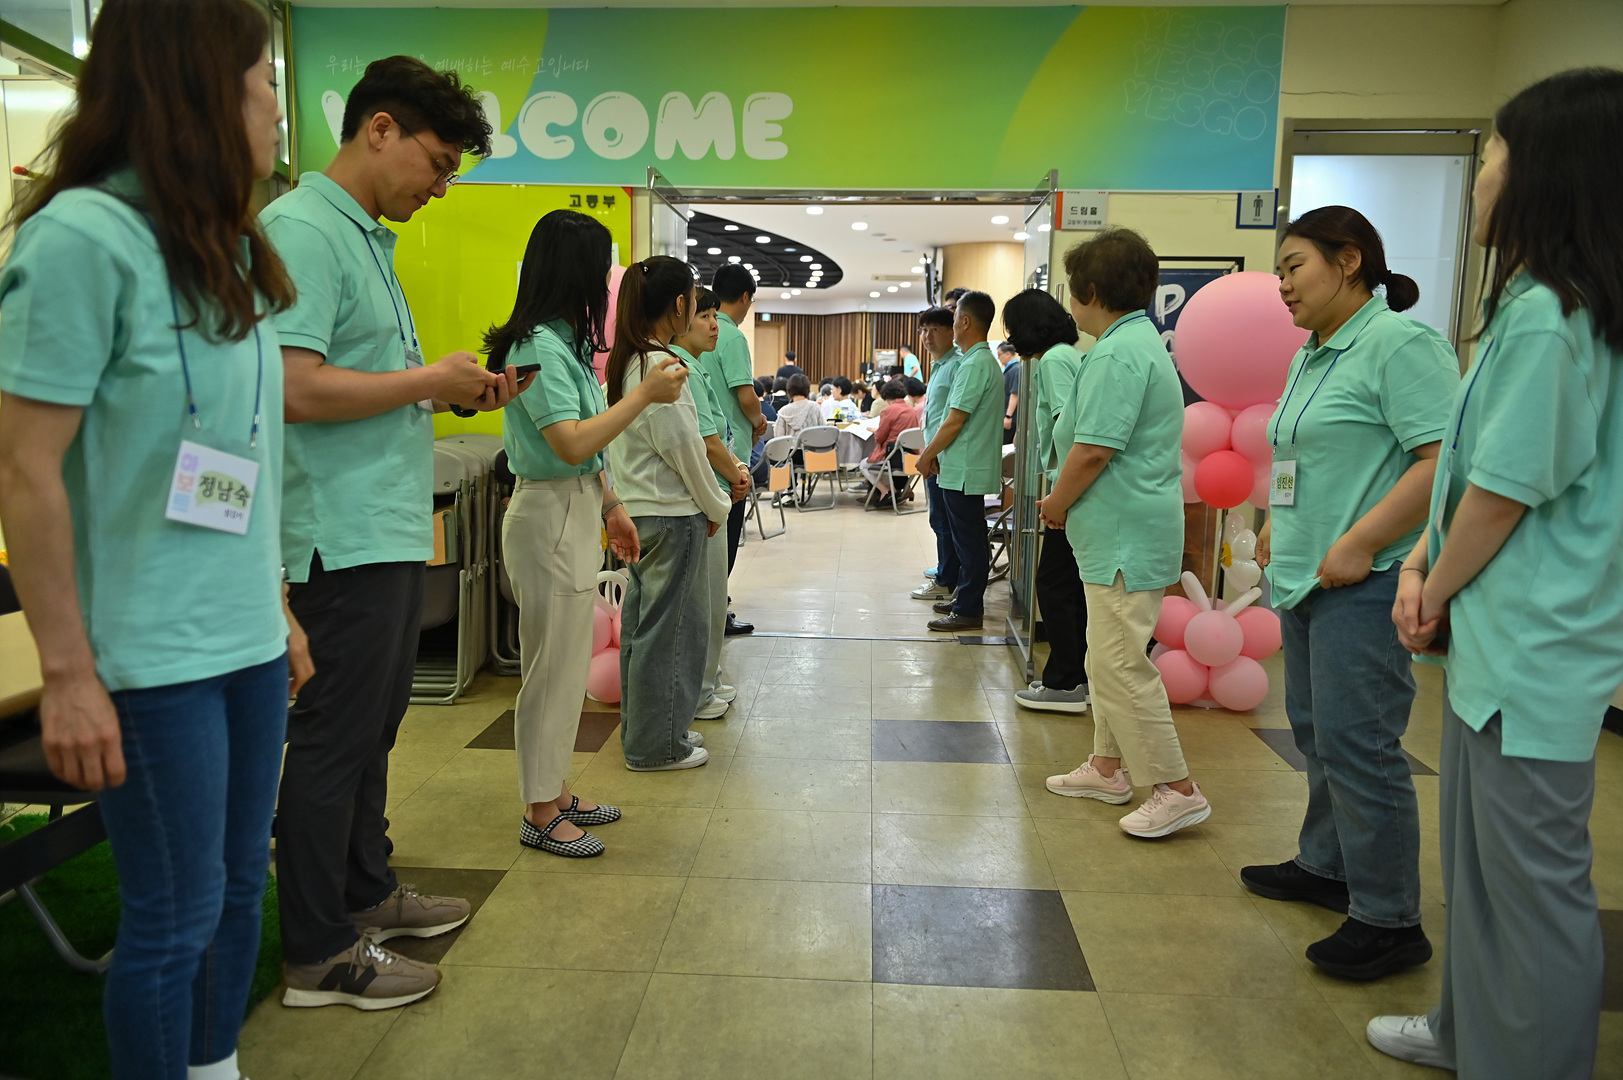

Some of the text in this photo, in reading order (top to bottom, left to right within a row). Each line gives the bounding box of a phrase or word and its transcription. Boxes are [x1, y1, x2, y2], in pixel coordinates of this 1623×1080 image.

[325, 54, 366, 73] 우리는
[321, 89, 794, 161] LCOME
[569, 194, 616, 208] 고등부
[198, 475, 251, 507] 정남숙
